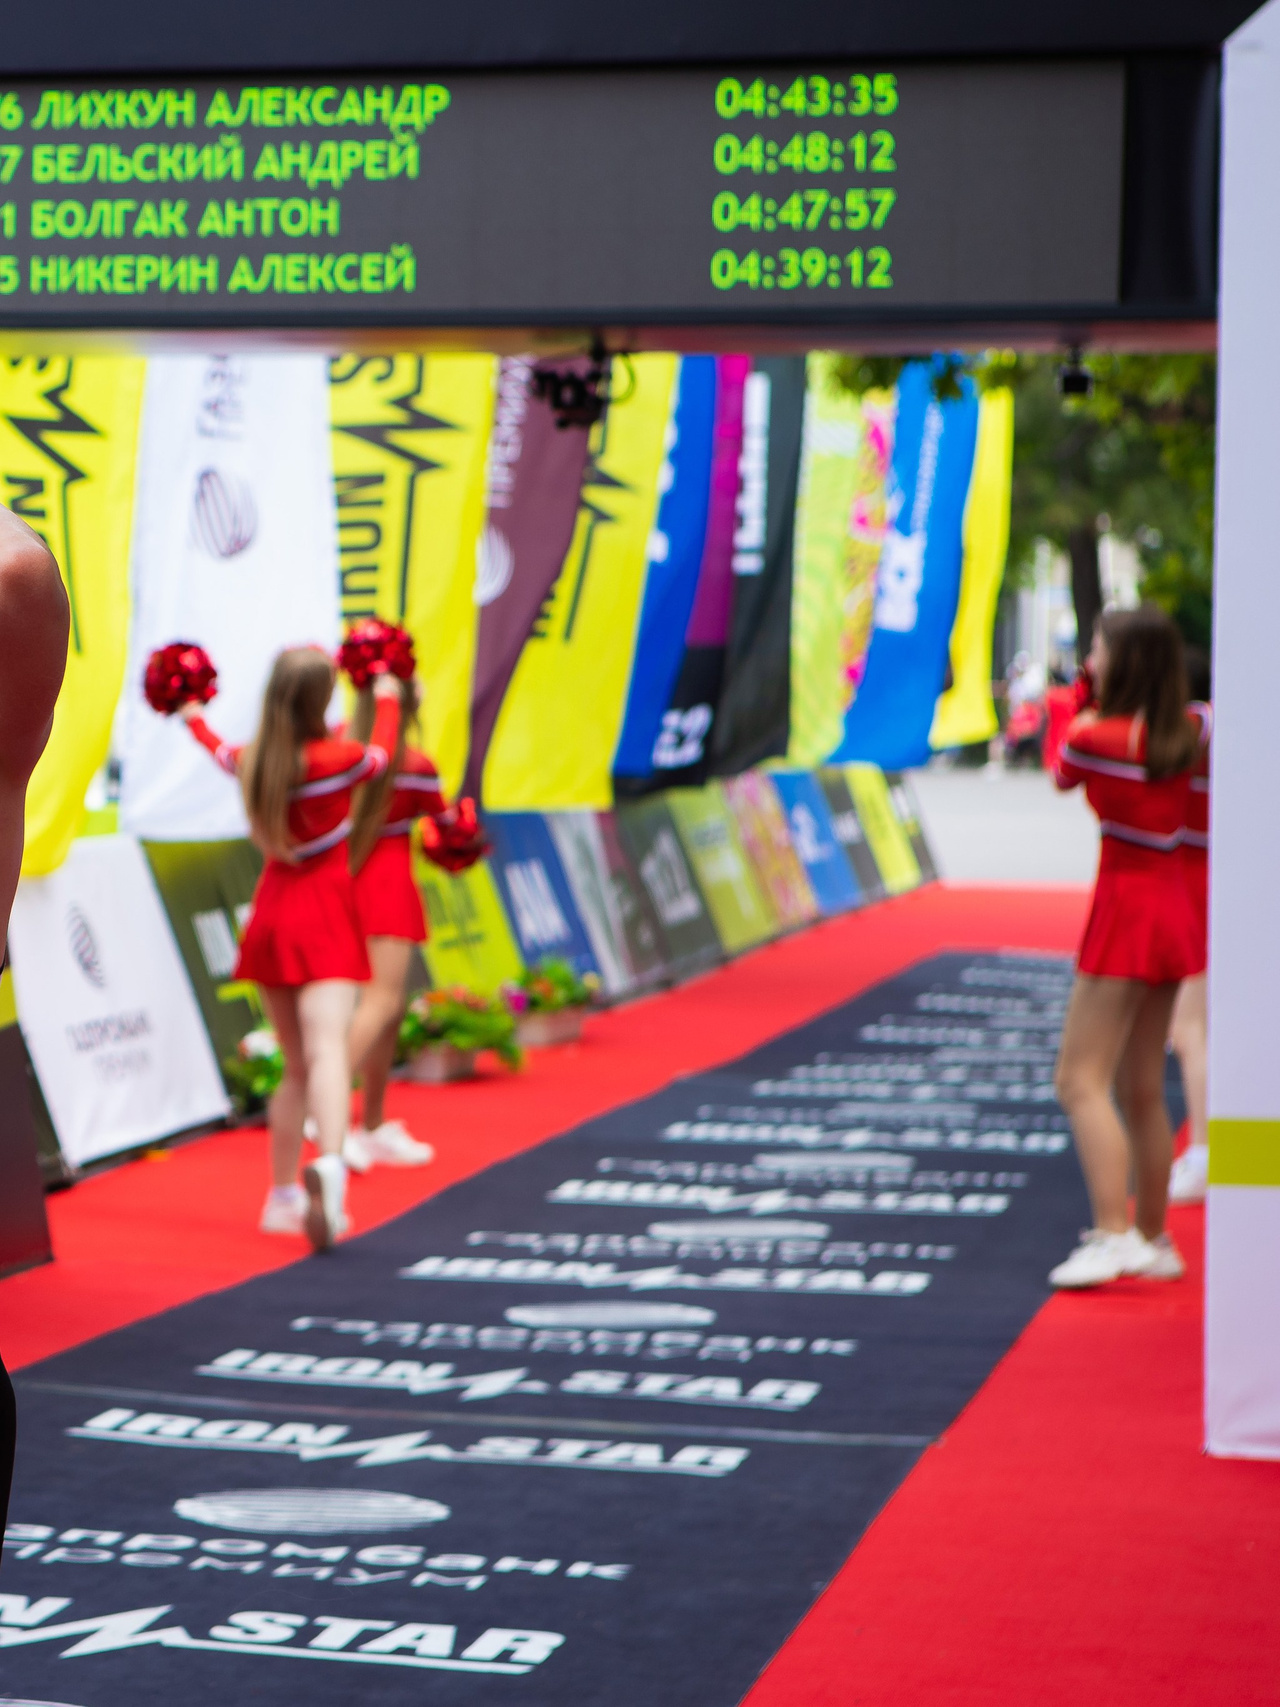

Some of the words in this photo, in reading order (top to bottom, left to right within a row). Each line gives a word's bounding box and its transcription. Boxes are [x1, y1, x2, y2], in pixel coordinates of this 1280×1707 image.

[30, 89, 197, 130] ЛИХКУН
[204, 83, 452, 134] АЛЕКСАНДР
[714, 73, 899, 119] 04:43:35
[31, 133, 245, 184] БЕЛЬСКИЙ
[253, 128, 422, 189] АНДРЕЙ
[713, 129, 896, 175] 04:48:12
[30, 198, 188, 239] БОЛГАК
[197, 197, 340, 238] АНТОН
[711, 187, 896, 233] 04:47:57
[29, 254, 219, 294] НИКЕРИН
[227, 244, 418, 294] АЛЕКСЕЙ
[709, 246, 893, 290] 04:39:12
[84, 1407, 351, 1446] IRON
[464, 1435, 751, 1469] STAR
[208, 1610, 567, 1665] STAR
